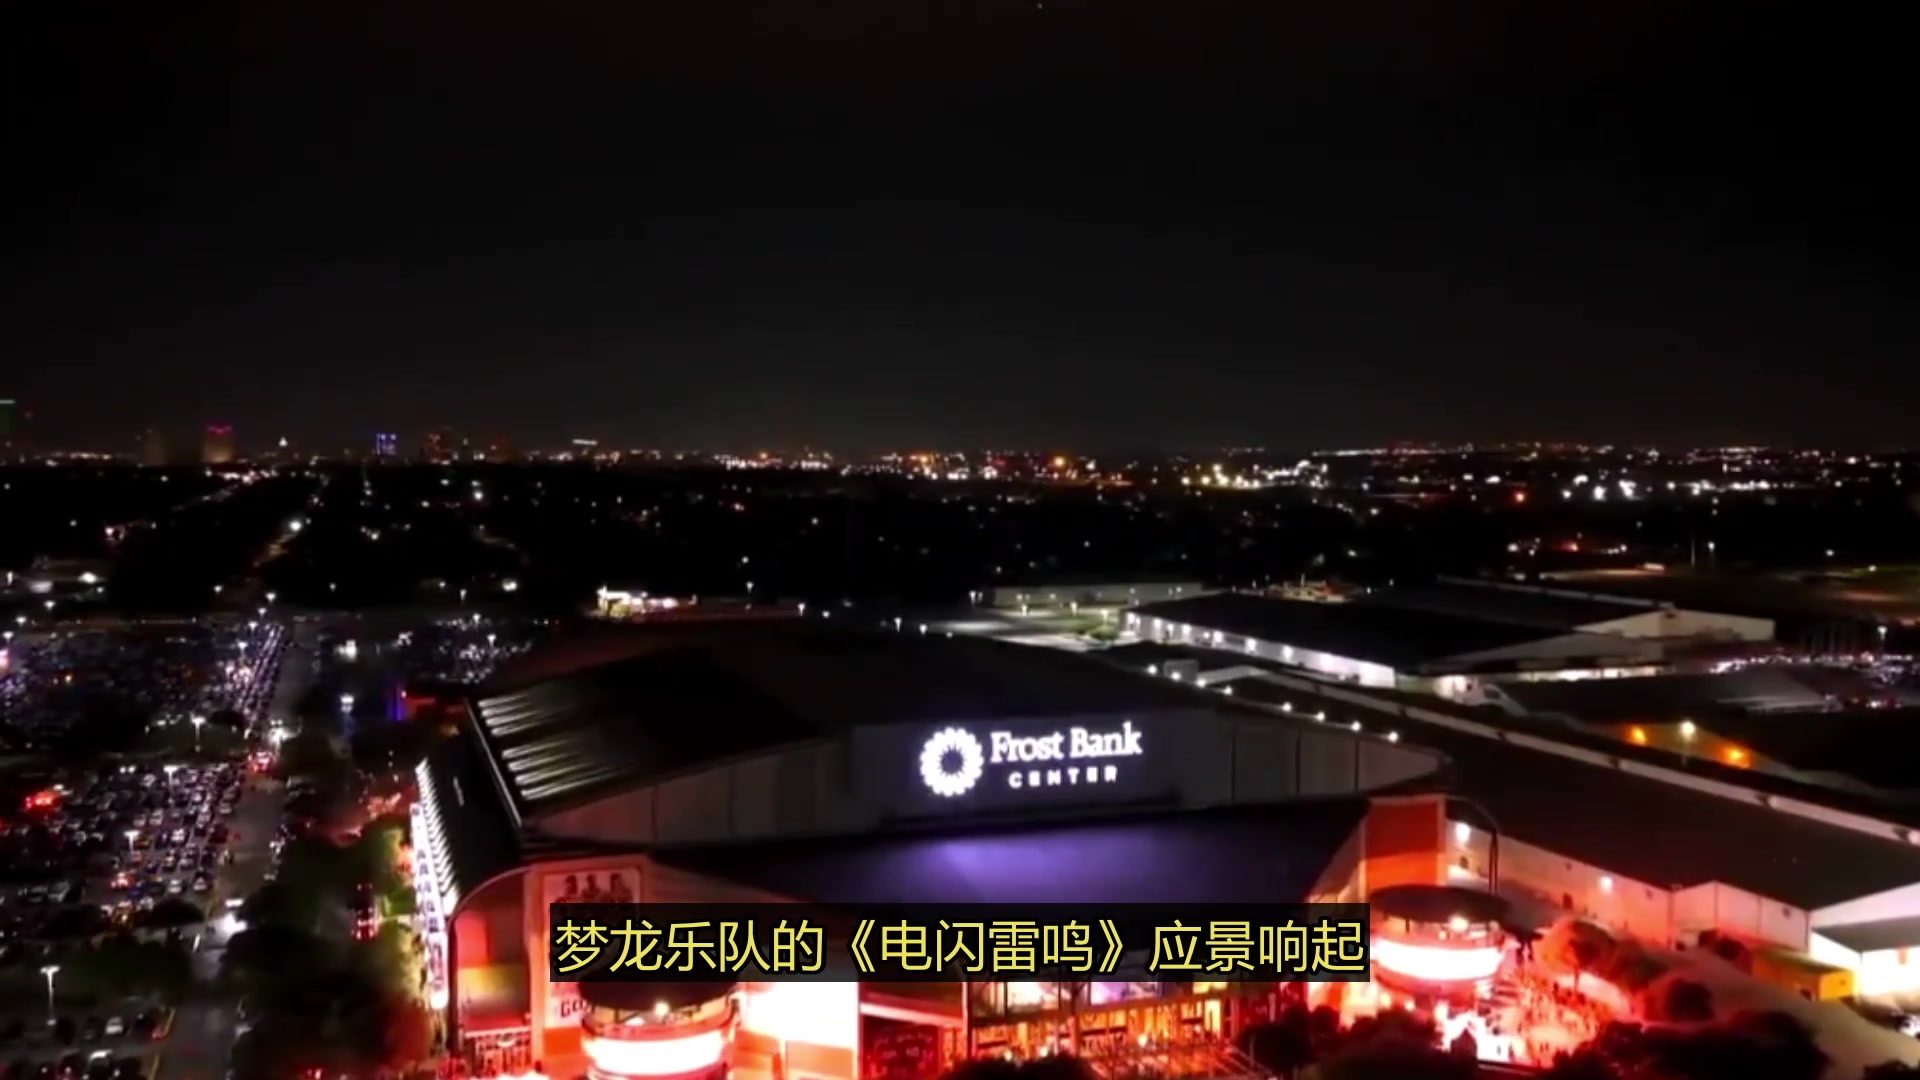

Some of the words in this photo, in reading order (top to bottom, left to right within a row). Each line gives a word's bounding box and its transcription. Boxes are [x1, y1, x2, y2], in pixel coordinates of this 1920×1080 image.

[990, 731, 1064, 763] Frost
[1069, 721, 1143, 758] Bank
[1008, 765, 1118, 788] CENTER
